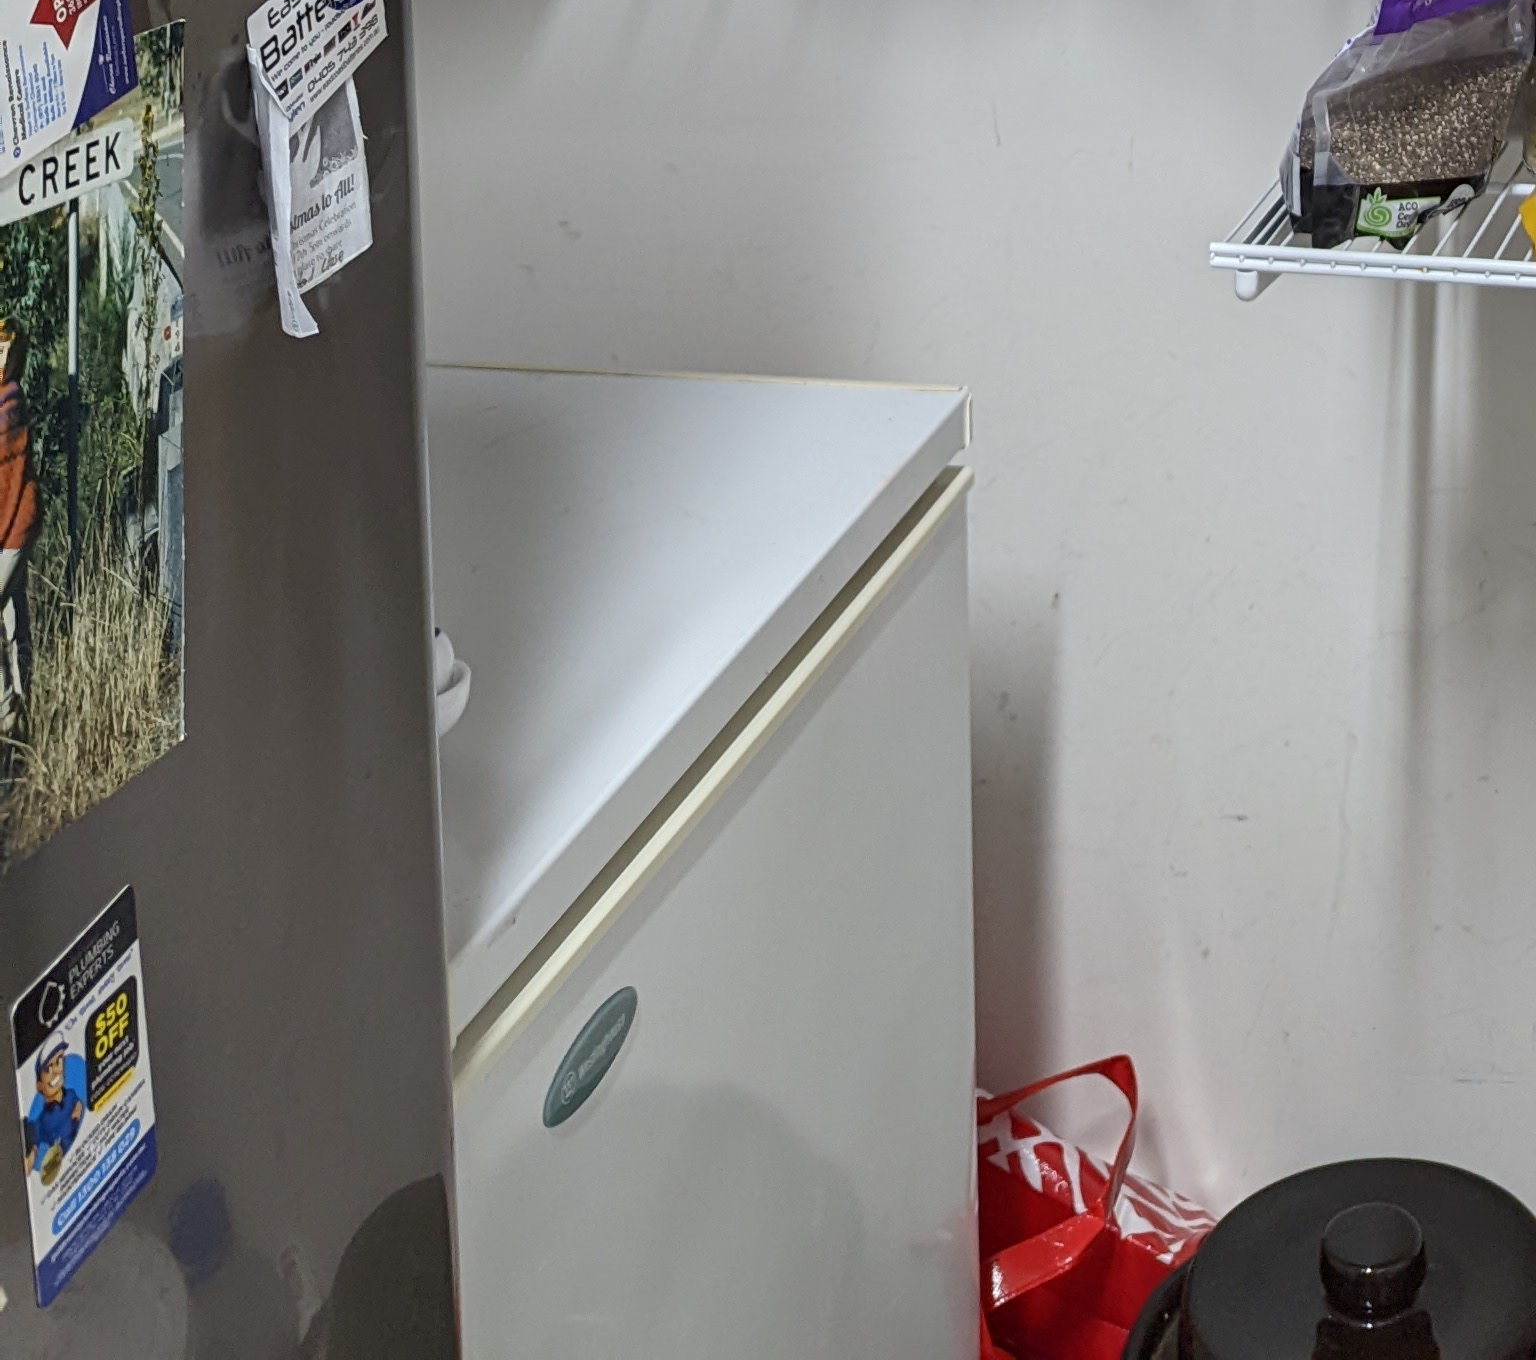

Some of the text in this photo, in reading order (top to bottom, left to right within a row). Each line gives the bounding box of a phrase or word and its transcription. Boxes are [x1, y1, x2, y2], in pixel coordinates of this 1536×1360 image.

[14, 68, 28, 142] Medical Centre
[18, 131, 122, 206] CREEK
[1398, 201, 1419, 212] ACO
[68, 919, 121, 984] PLUMBING
[70, 943, 115, 1000] EXPERTS
[94, 991, 129, 1038] $50
[94, 1011, 131, 1060] OFF
